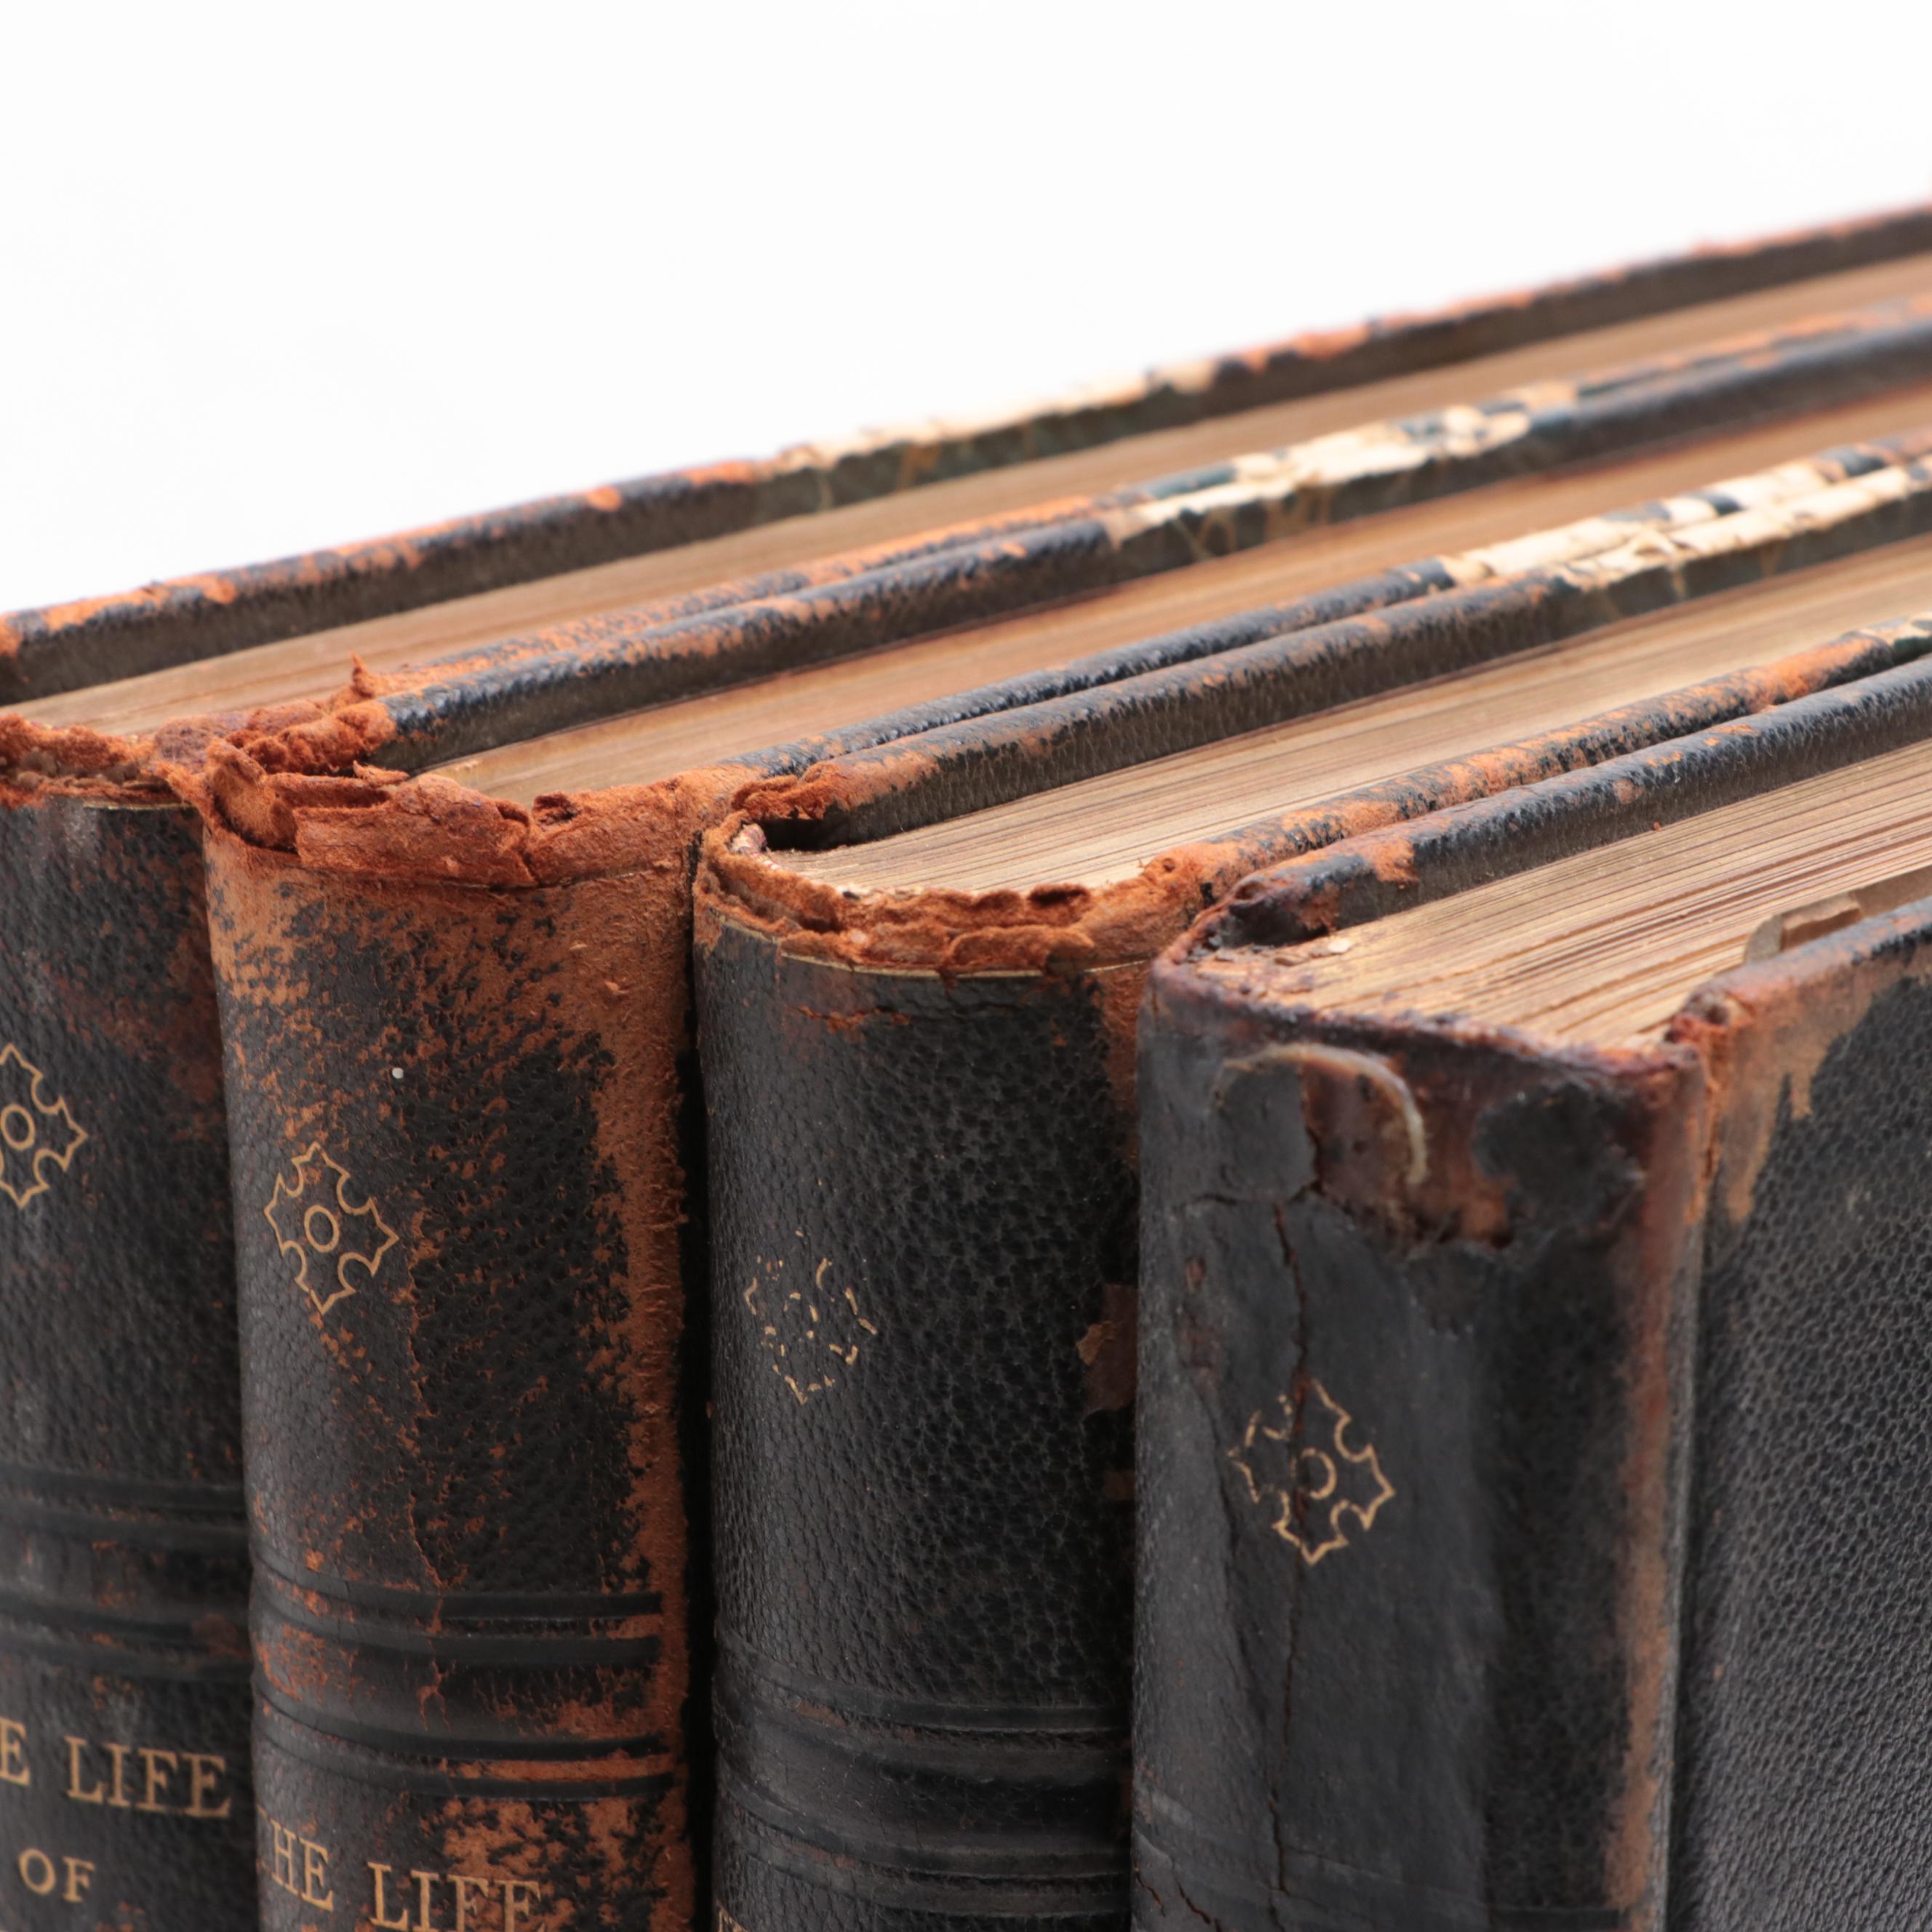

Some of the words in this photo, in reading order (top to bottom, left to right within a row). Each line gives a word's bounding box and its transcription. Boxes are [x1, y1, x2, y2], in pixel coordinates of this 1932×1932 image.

[63, 1735, 232, 1818] LIFE
[18, 1848, 95, 1903] OF
[367, 1861, 546, 1932] LIFE
